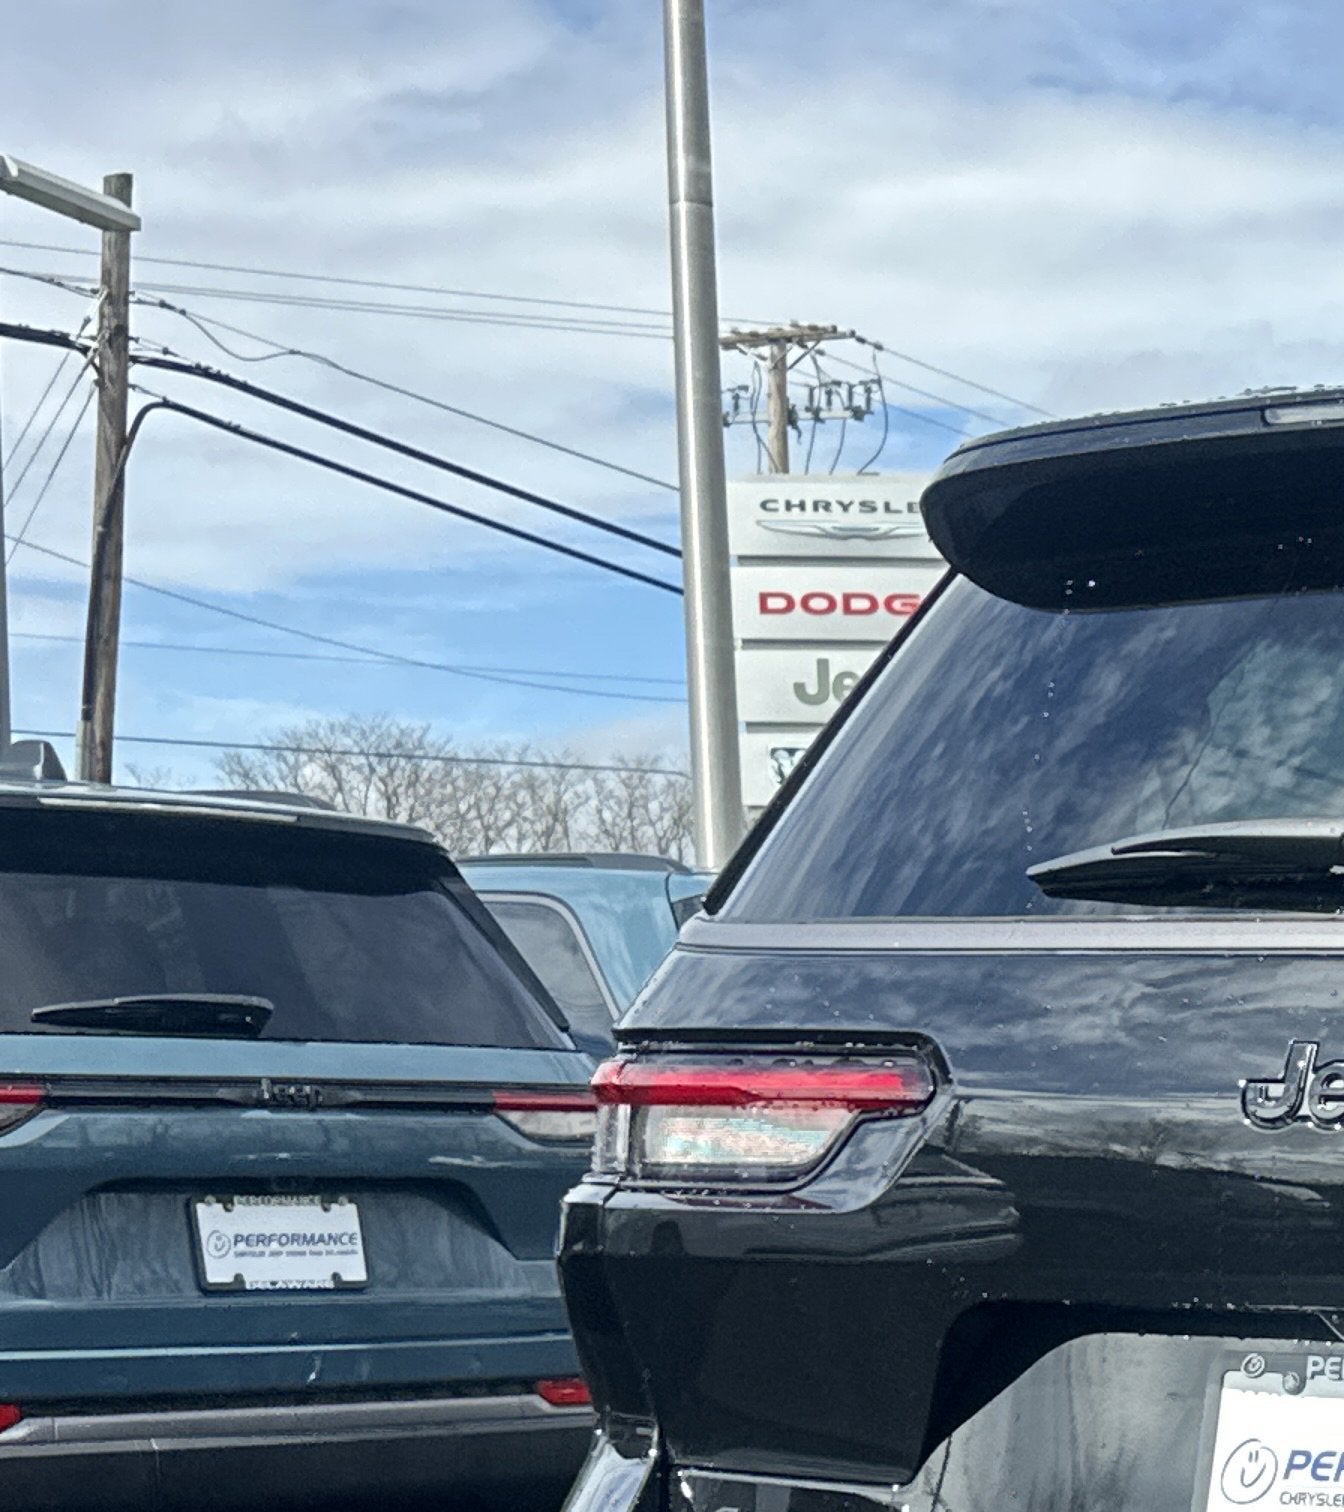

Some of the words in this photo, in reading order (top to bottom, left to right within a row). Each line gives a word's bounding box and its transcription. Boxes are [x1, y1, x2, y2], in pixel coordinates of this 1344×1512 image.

[759, 499, 921, 514] CHRYSLE
[758, 592, 922, 616] DODG
[793, 658, 862, 706] Je
[233, 1232, 358, 1248] PERFORMANCE
